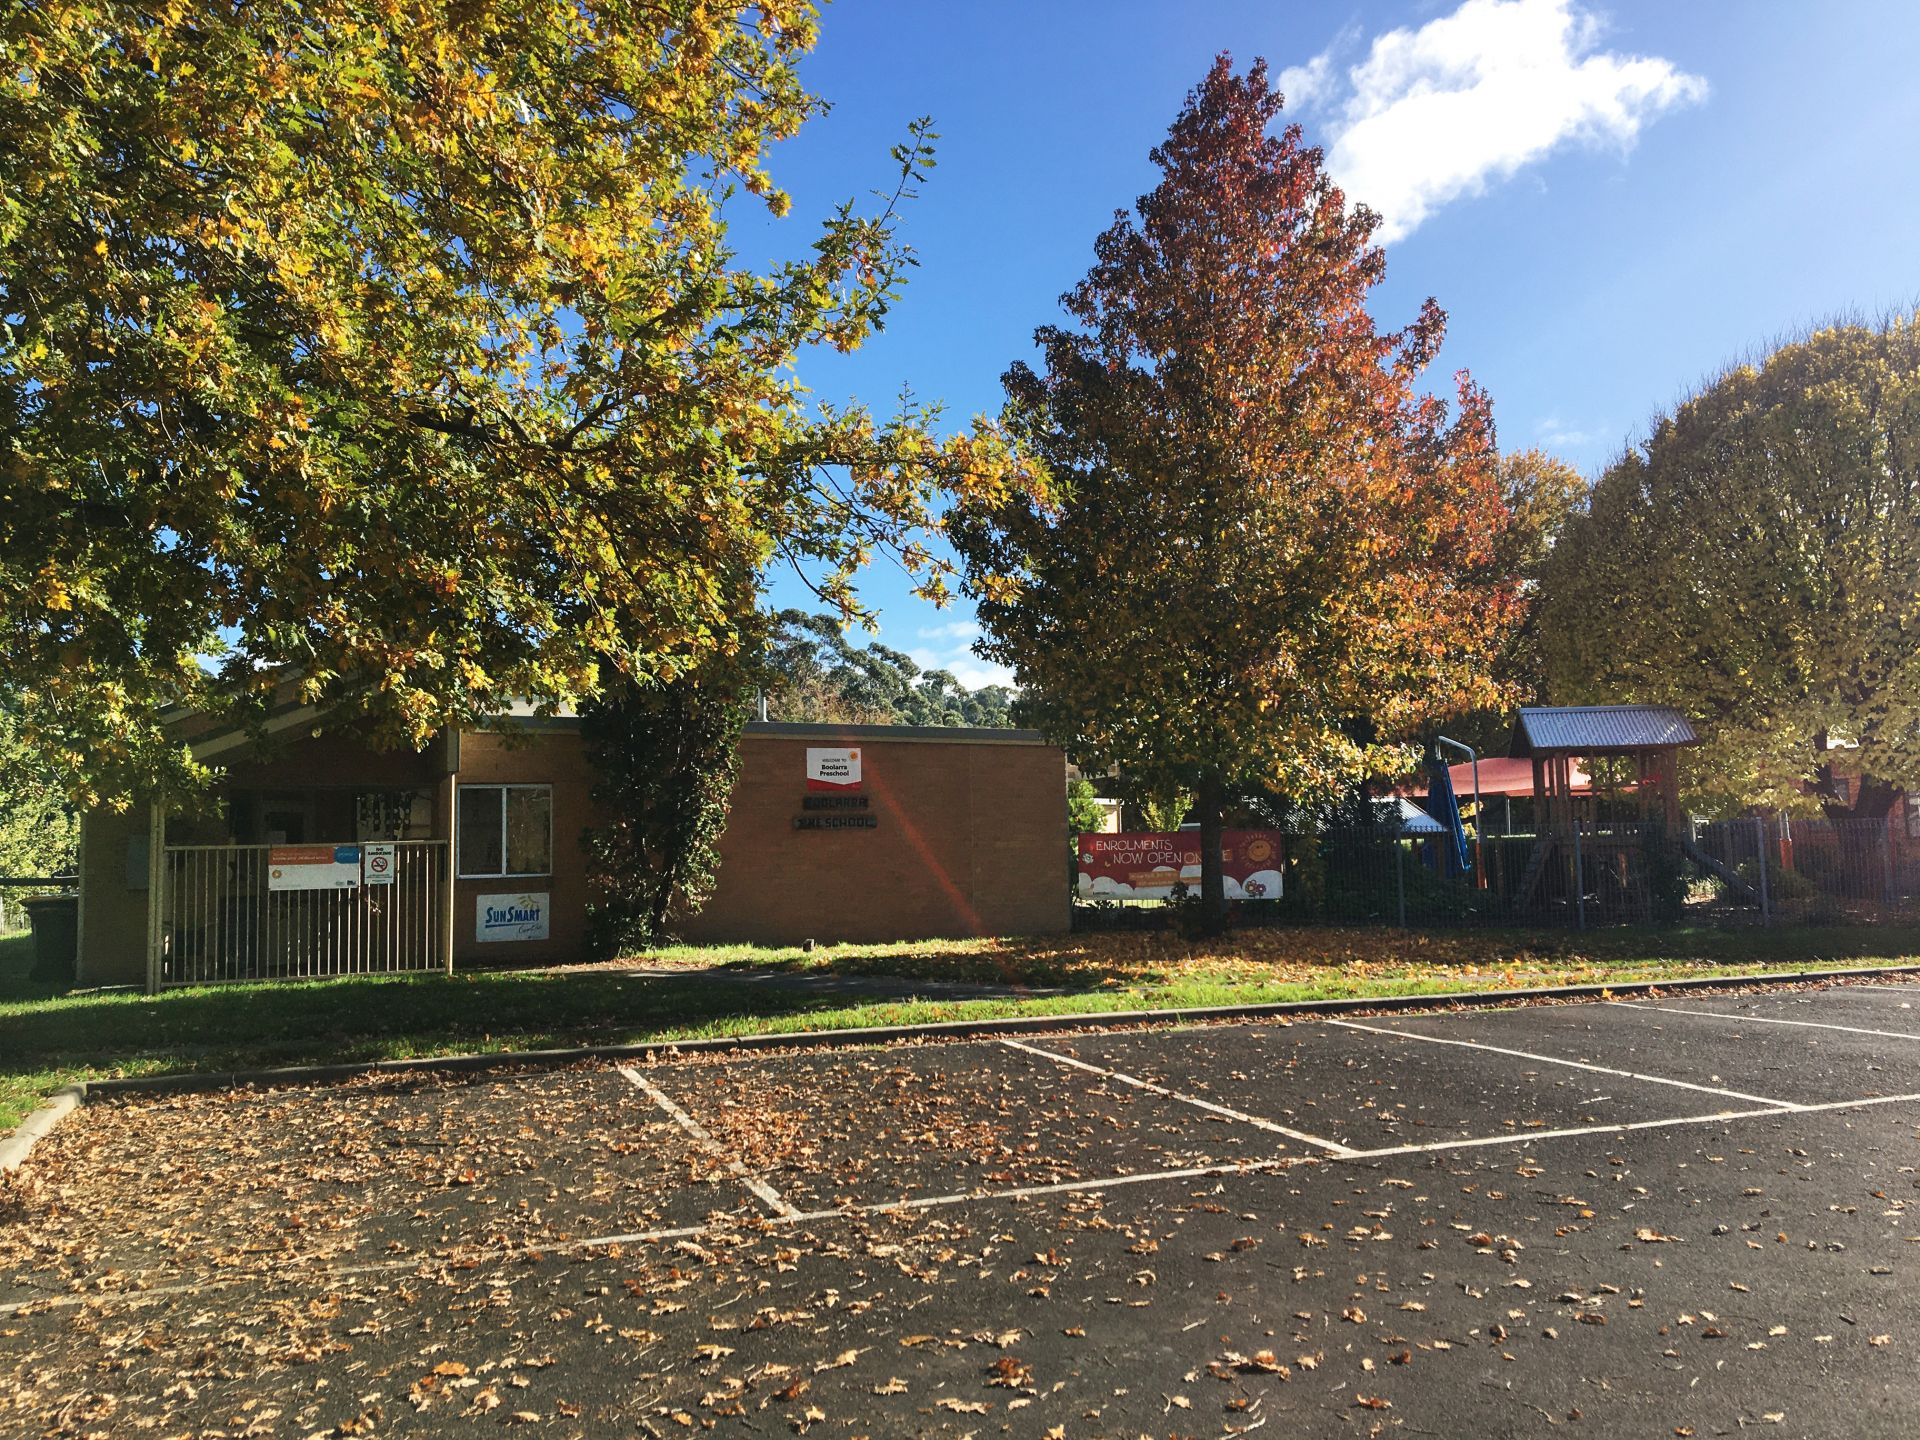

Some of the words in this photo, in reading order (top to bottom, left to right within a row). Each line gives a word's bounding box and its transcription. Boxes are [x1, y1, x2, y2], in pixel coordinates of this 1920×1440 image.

[825, 816, 877, 828] SCHOOL
[1096, 839, 1173, 851] ENROLMENTS
[1113, 852, 1143, 864] NOW
[1147, 851, 1182, 864] OPEN
